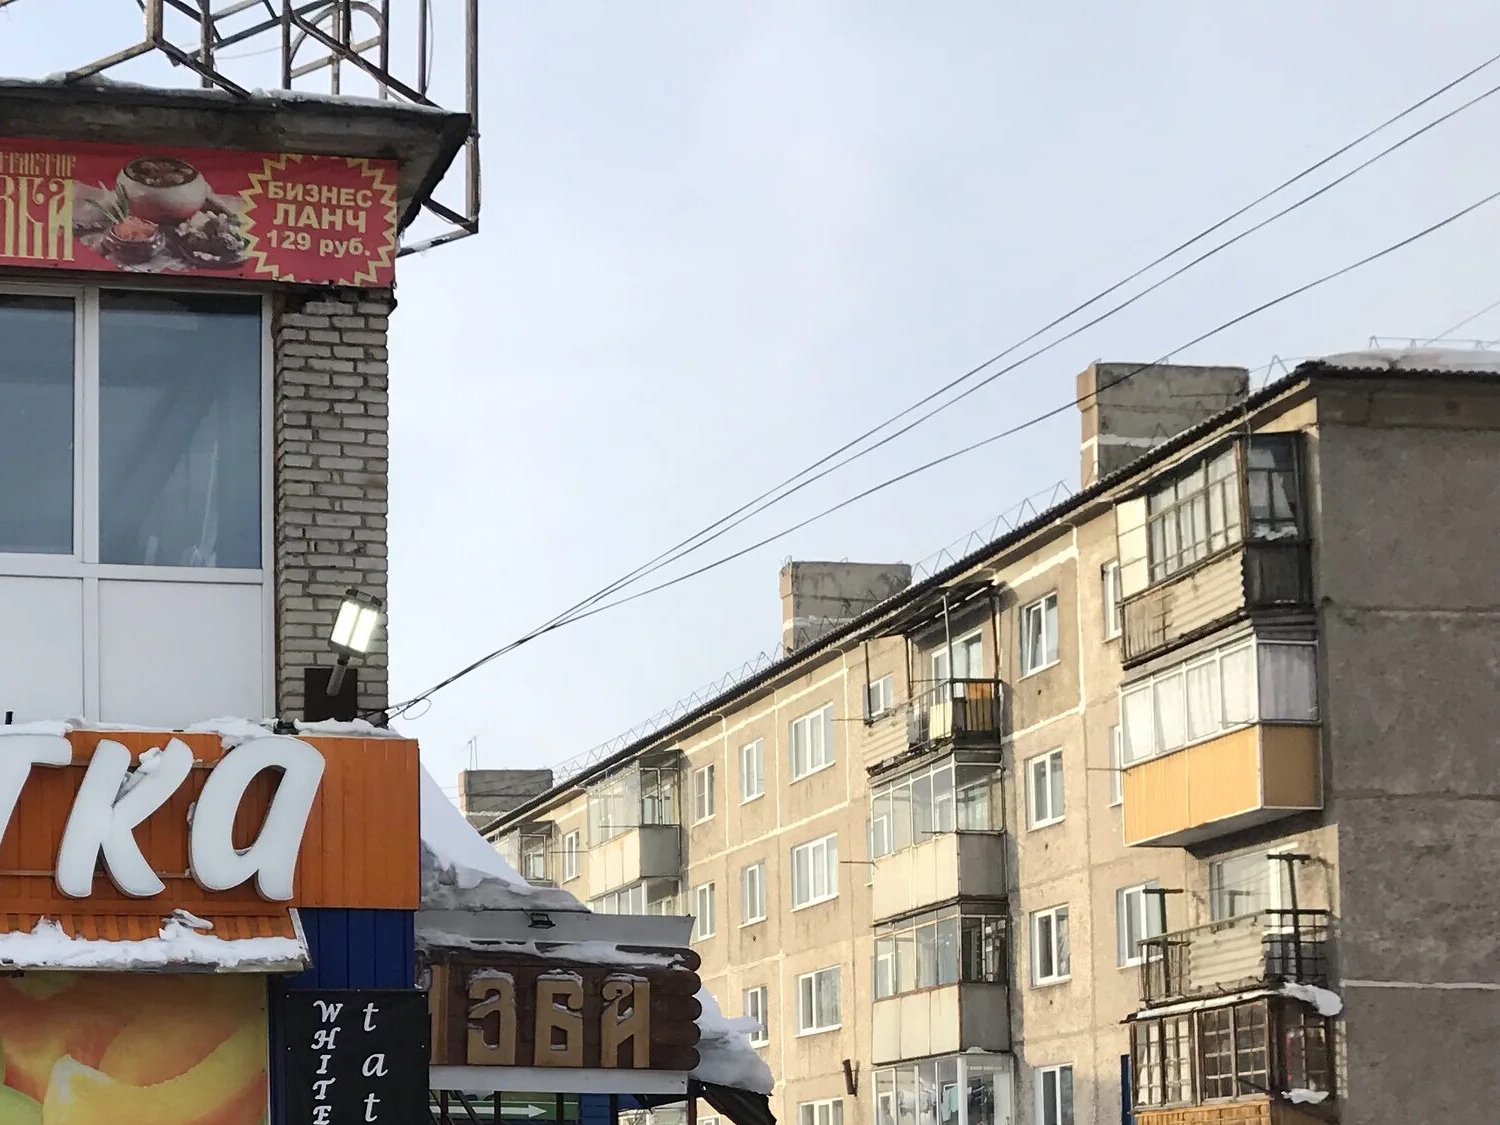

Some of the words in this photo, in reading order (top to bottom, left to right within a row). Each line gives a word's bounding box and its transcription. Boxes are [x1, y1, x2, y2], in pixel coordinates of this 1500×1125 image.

[268, 181, 373, 208] БИЗНЕС
[273, 203, 367, 234] ЛАНЧ
[266, 230, 311, 250] 129
[319, 237, 371, 258] руб.
